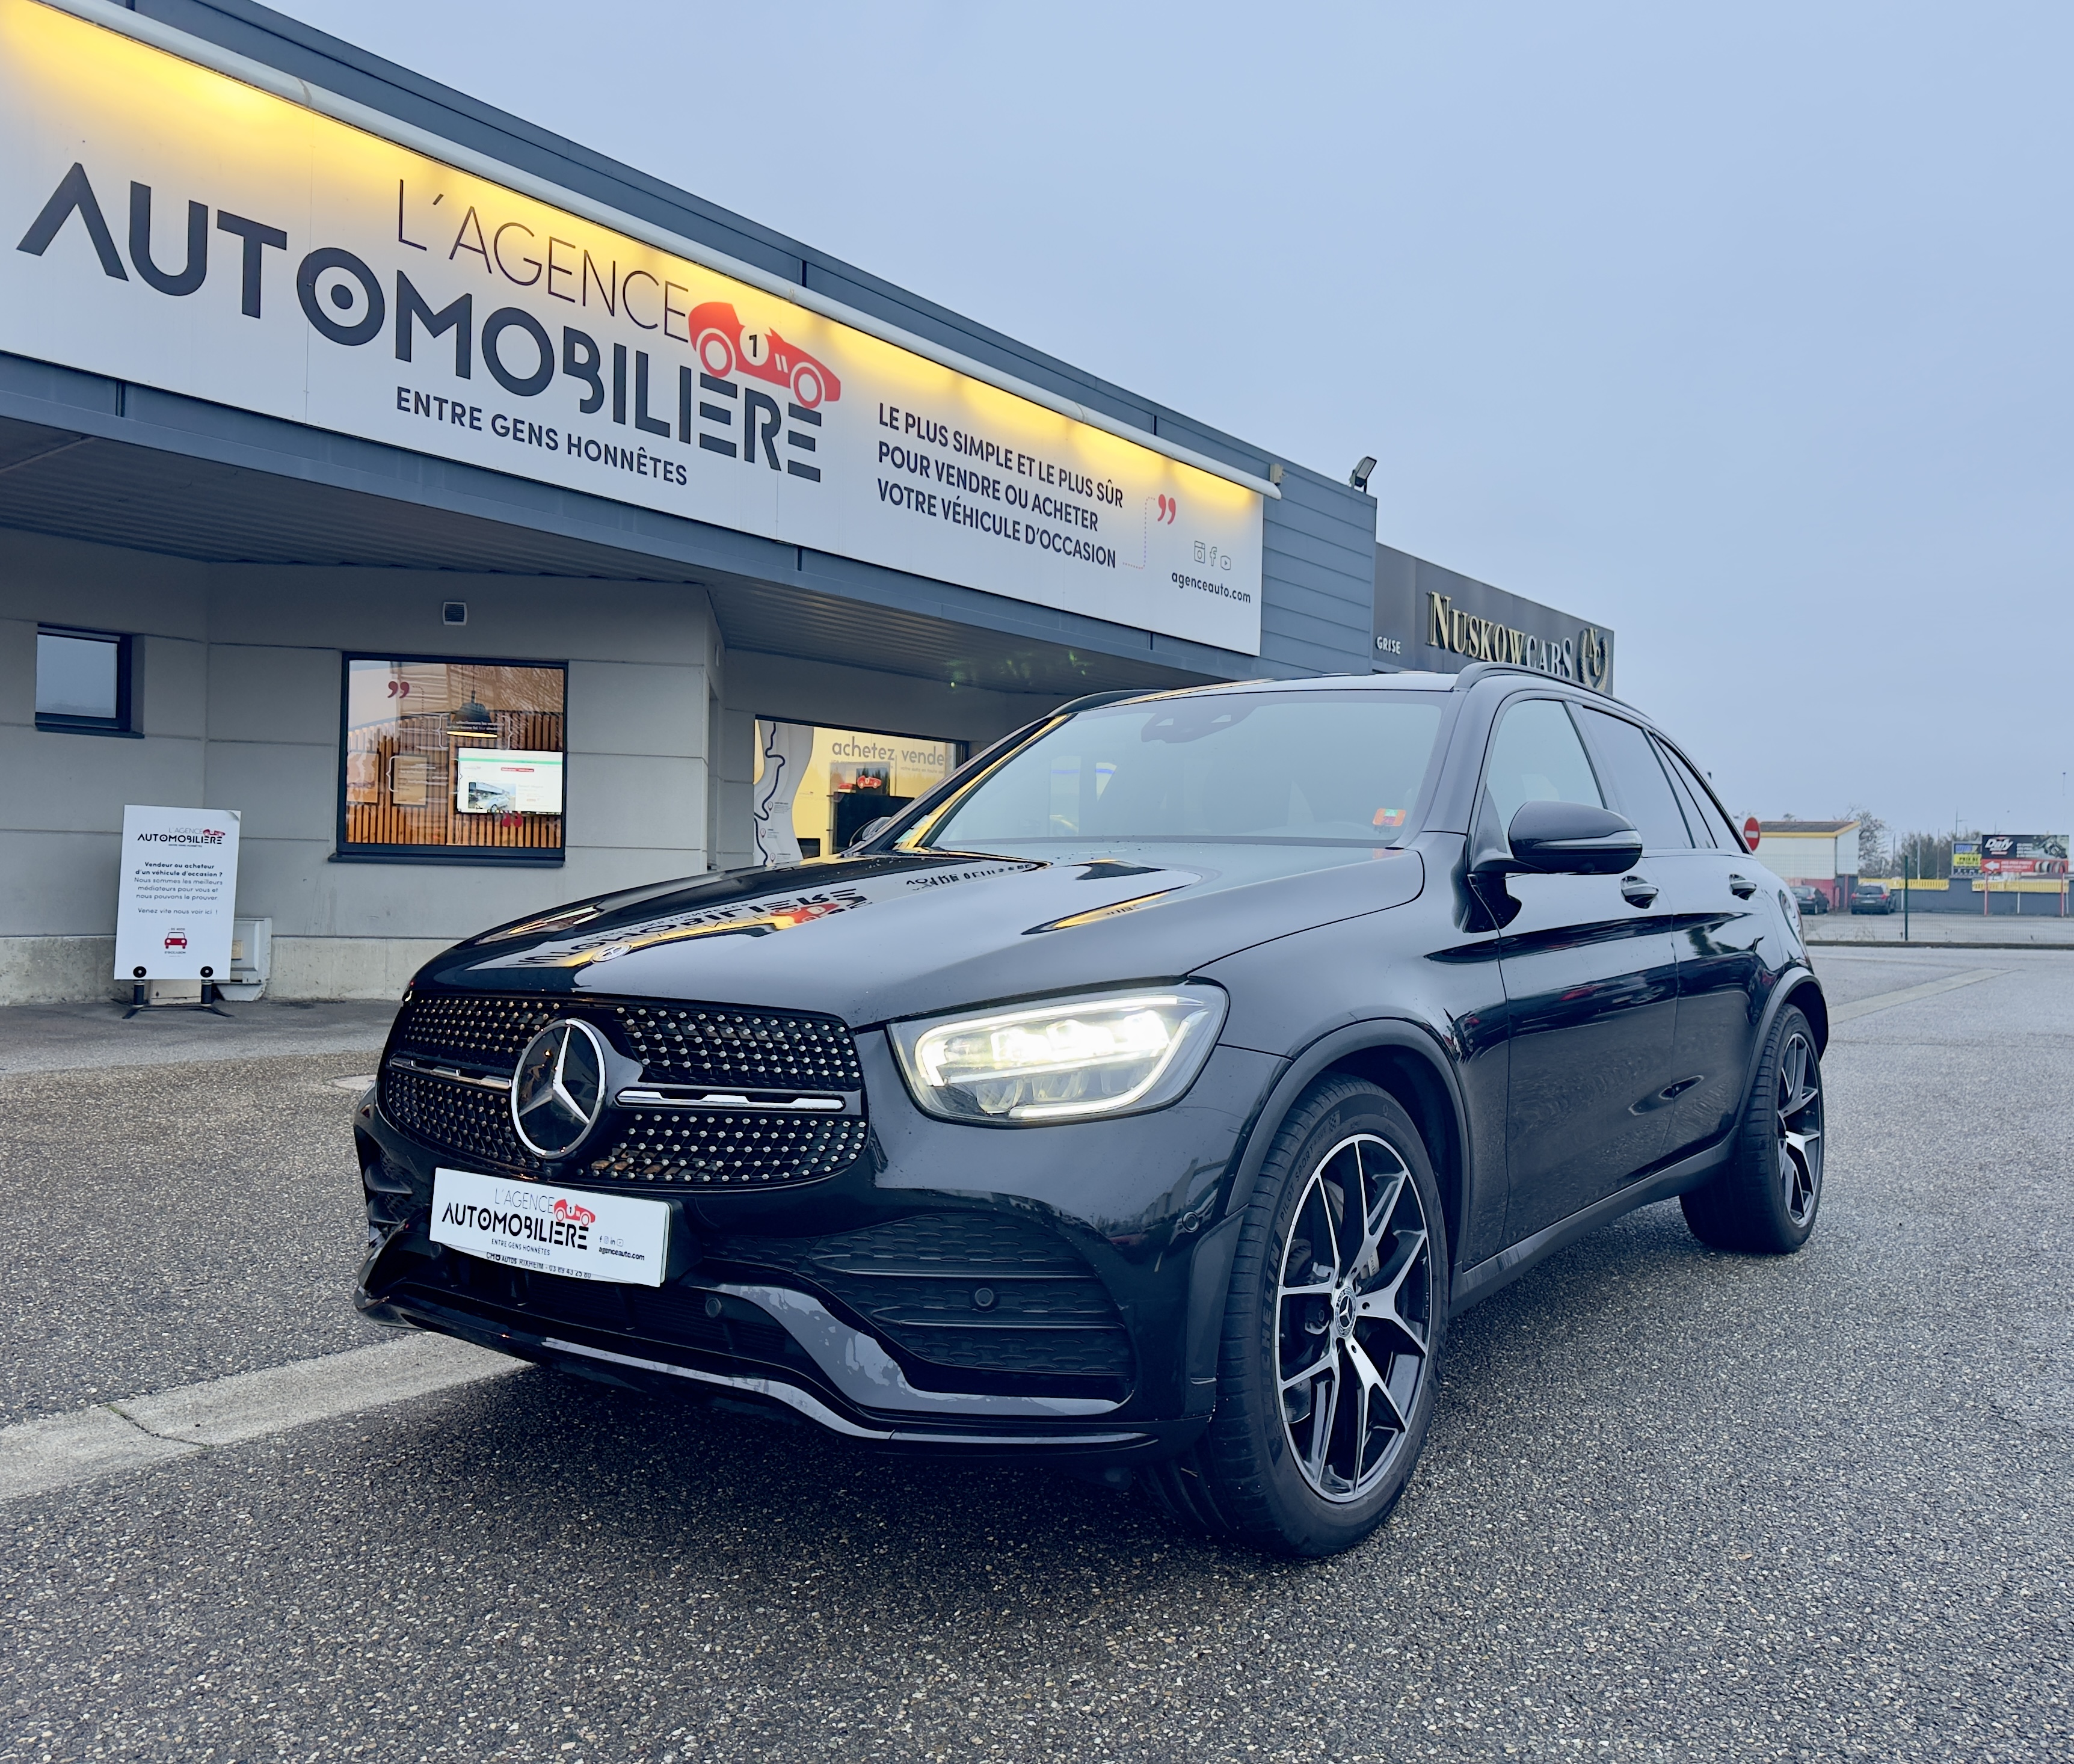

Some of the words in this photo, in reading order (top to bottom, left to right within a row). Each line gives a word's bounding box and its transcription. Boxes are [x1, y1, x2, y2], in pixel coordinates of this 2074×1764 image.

[398, 179, 689, 343] L'AGENCE
[16, 162, 822, 482] AUTOMOBILIERE
[749, 334, 757, 358] 1
[397, 386, 482, 431] ENTRE
[491, 414, 558, 451] GENS
[567, 435, 688, 485] HONNÊTES
[879, 402, 899, 431] LE
[905, 410, 948, 447] PLUS
[953, 431, 1012, 470] SIMPLE
[1017, 453, 1035, 477] ET
[1038, 461, 1054, 484] LE
[1059, 466, 1093, 497] PLUS
[1097, 479, 1123, 509] SÛR
[879, 441, 930, 479] POUR
[934, 461, 1000, 501] VENDRE
[1005, 485, 1028, 509] OU
[1031, 494, 1098, 531] ACHETER
[878, 478, 937, 517] VOTRE
[941, 497, 1021, 541] VÉHICULE
[1026, 527, 1116, 568] D'OCCASION
[1172, 572, 1251, 603] agenceauto.com
[1376, 636, 1401, 654] GRISE
[832, 736, 896, 761] achetez
[137, 834, 223, 844] AUTOMOBILIERE
[494, 1187, 555, 1214] L'AGENCE
[1280, 1182, 1294, 1222] PILOT
[1295, 1146, 1313, 1182] SPORT
[442, 1202, 589, 1250] AUTOMOBILIERE
[491, 1238, 507, 1247] ENTRE
[508, 1241, 522, 1250] GENS
[523, 1245, 550, 1256] HONNÊTES
[599, 1247, 645, 1261] agenceauto.com
